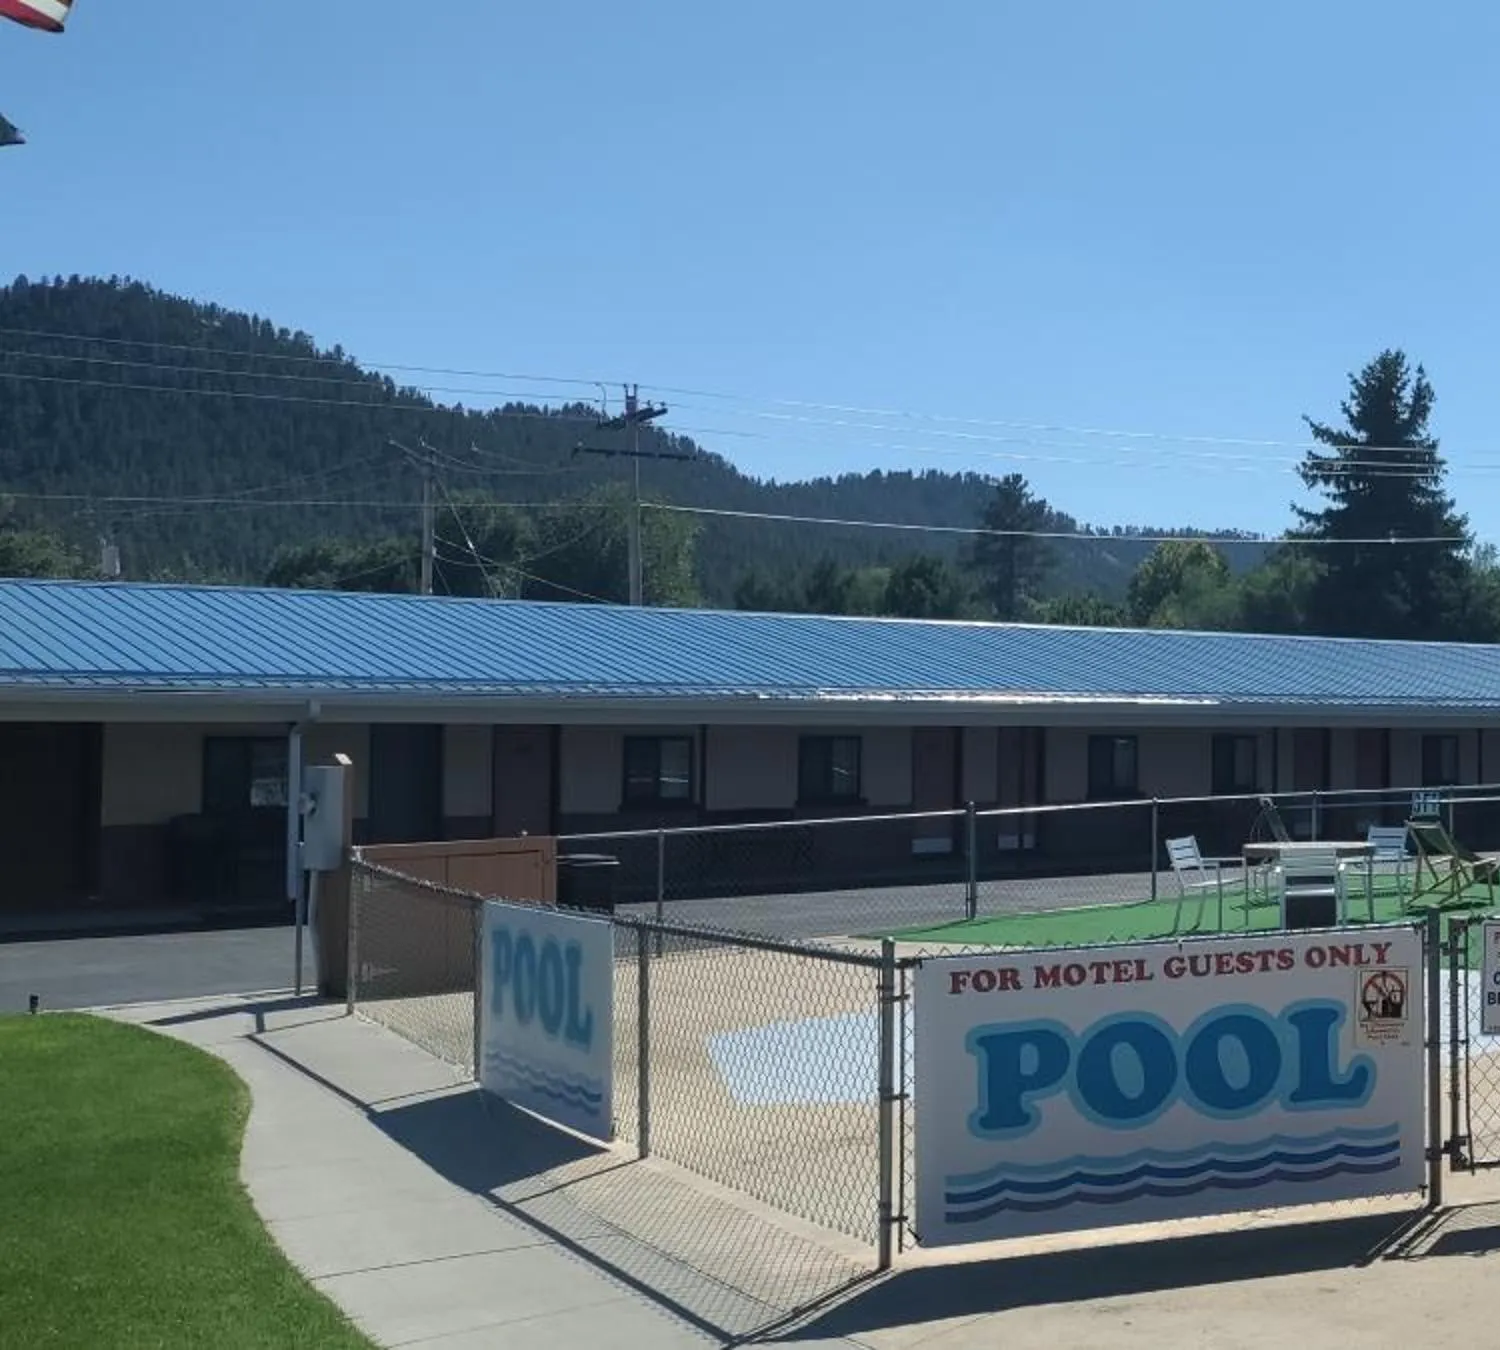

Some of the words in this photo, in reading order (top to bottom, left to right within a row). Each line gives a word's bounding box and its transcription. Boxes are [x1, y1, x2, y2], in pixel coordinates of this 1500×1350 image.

[492, 929, 593, 1047] POOL
[950, 965, 1023, 995] FOR
[1033, 959, 1154, 990] MOTEL
[1163, 947, 1295, 980] GUESTS
[1304, 941, 1393, 969] ONLY
[970, 1001, 1374, 1137] POOL
